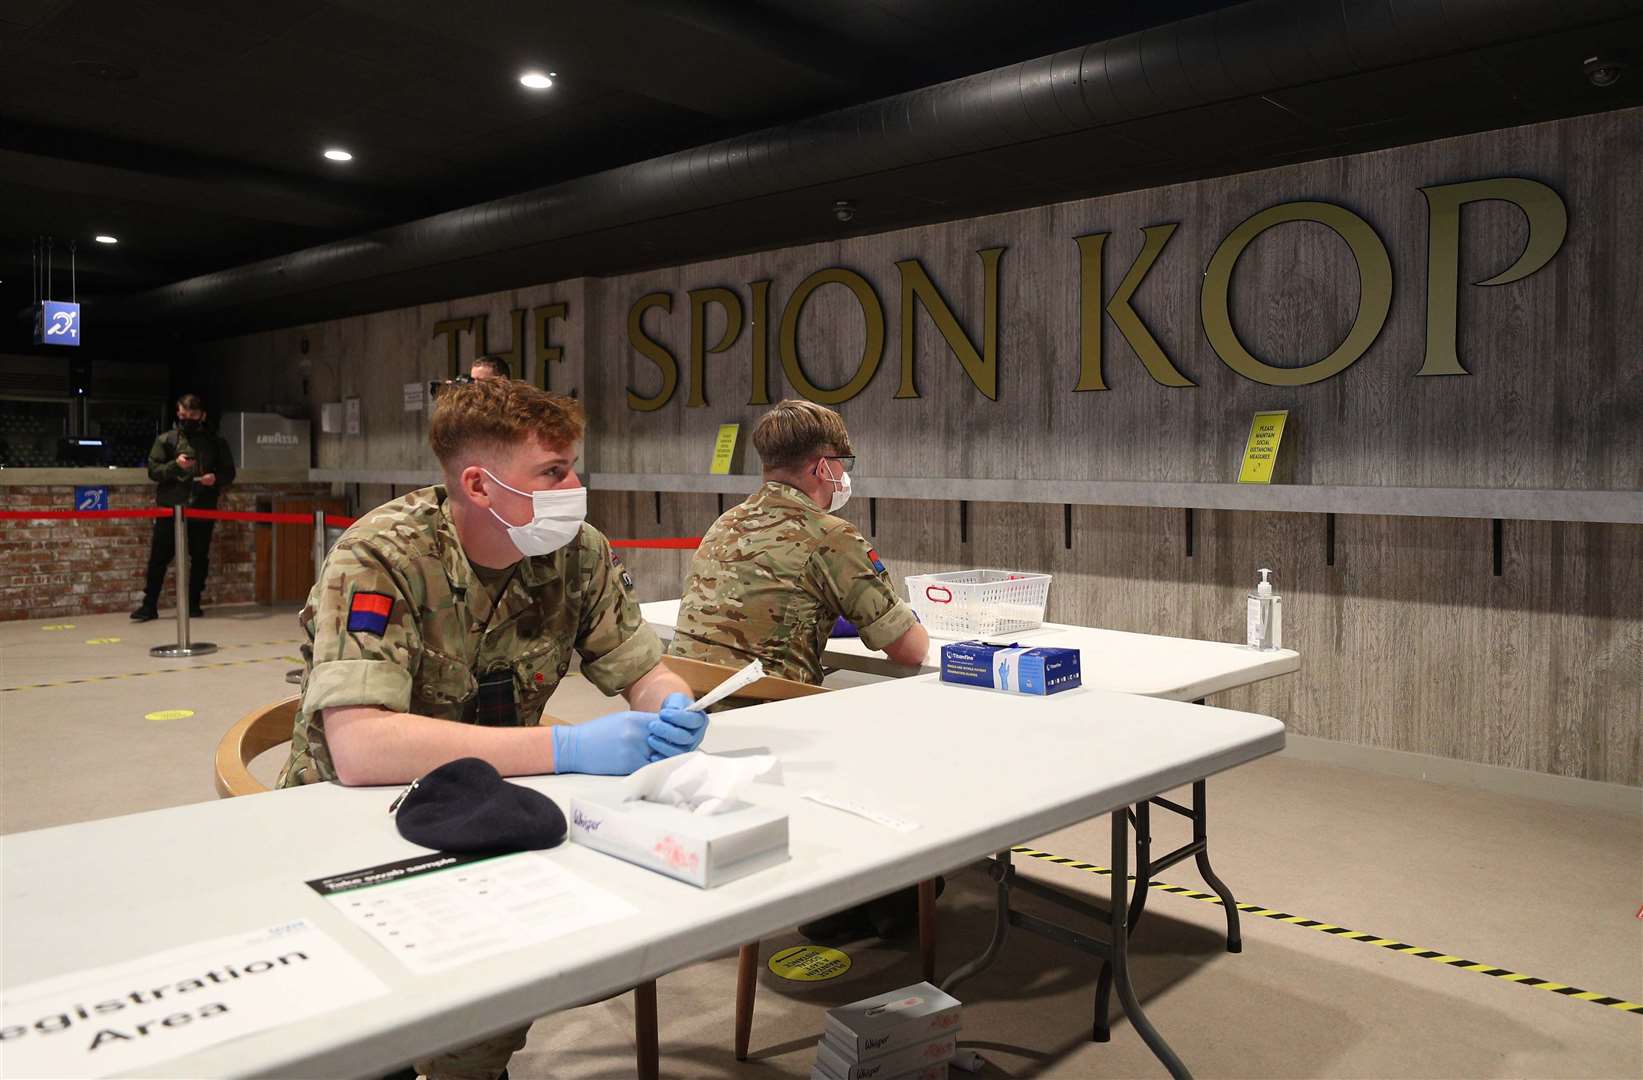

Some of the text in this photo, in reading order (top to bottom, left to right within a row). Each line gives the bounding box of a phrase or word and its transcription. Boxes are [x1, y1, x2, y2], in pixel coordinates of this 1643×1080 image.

[433, 176, 1568, 412] THE SPION KOP
[573, 808, 604, 832] Whisper
[325, 878, 363, 891] Take
[87, 1000, 231, 1052] Area
